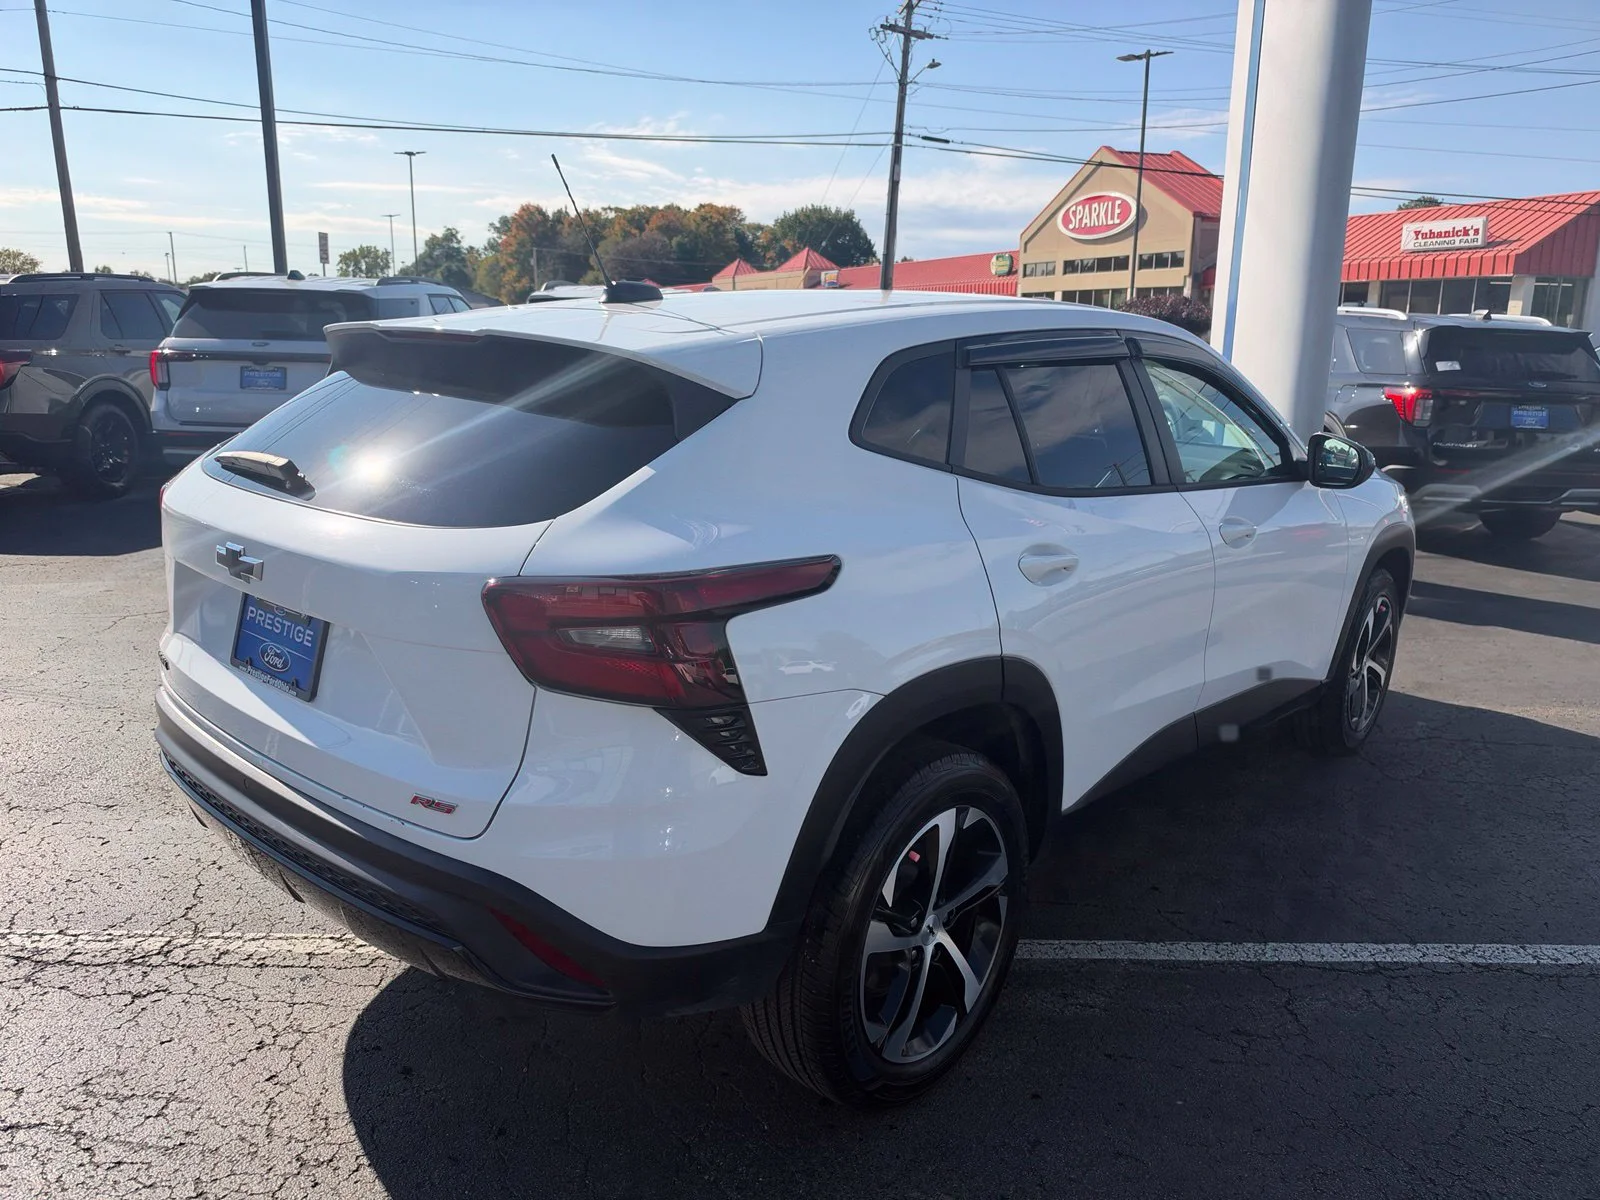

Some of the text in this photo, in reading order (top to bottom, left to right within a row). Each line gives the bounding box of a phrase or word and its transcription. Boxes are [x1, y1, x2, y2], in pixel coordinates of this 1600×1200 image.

[1068, 200, 1122, 230] SPARKLE
[1413, 237, 1479, 248] CLEANING FAIR
[246, 606, 314, 648] PRESTIGE
[264, 645, 285, 669] Ford
[410, 793, 458, 815] RS
